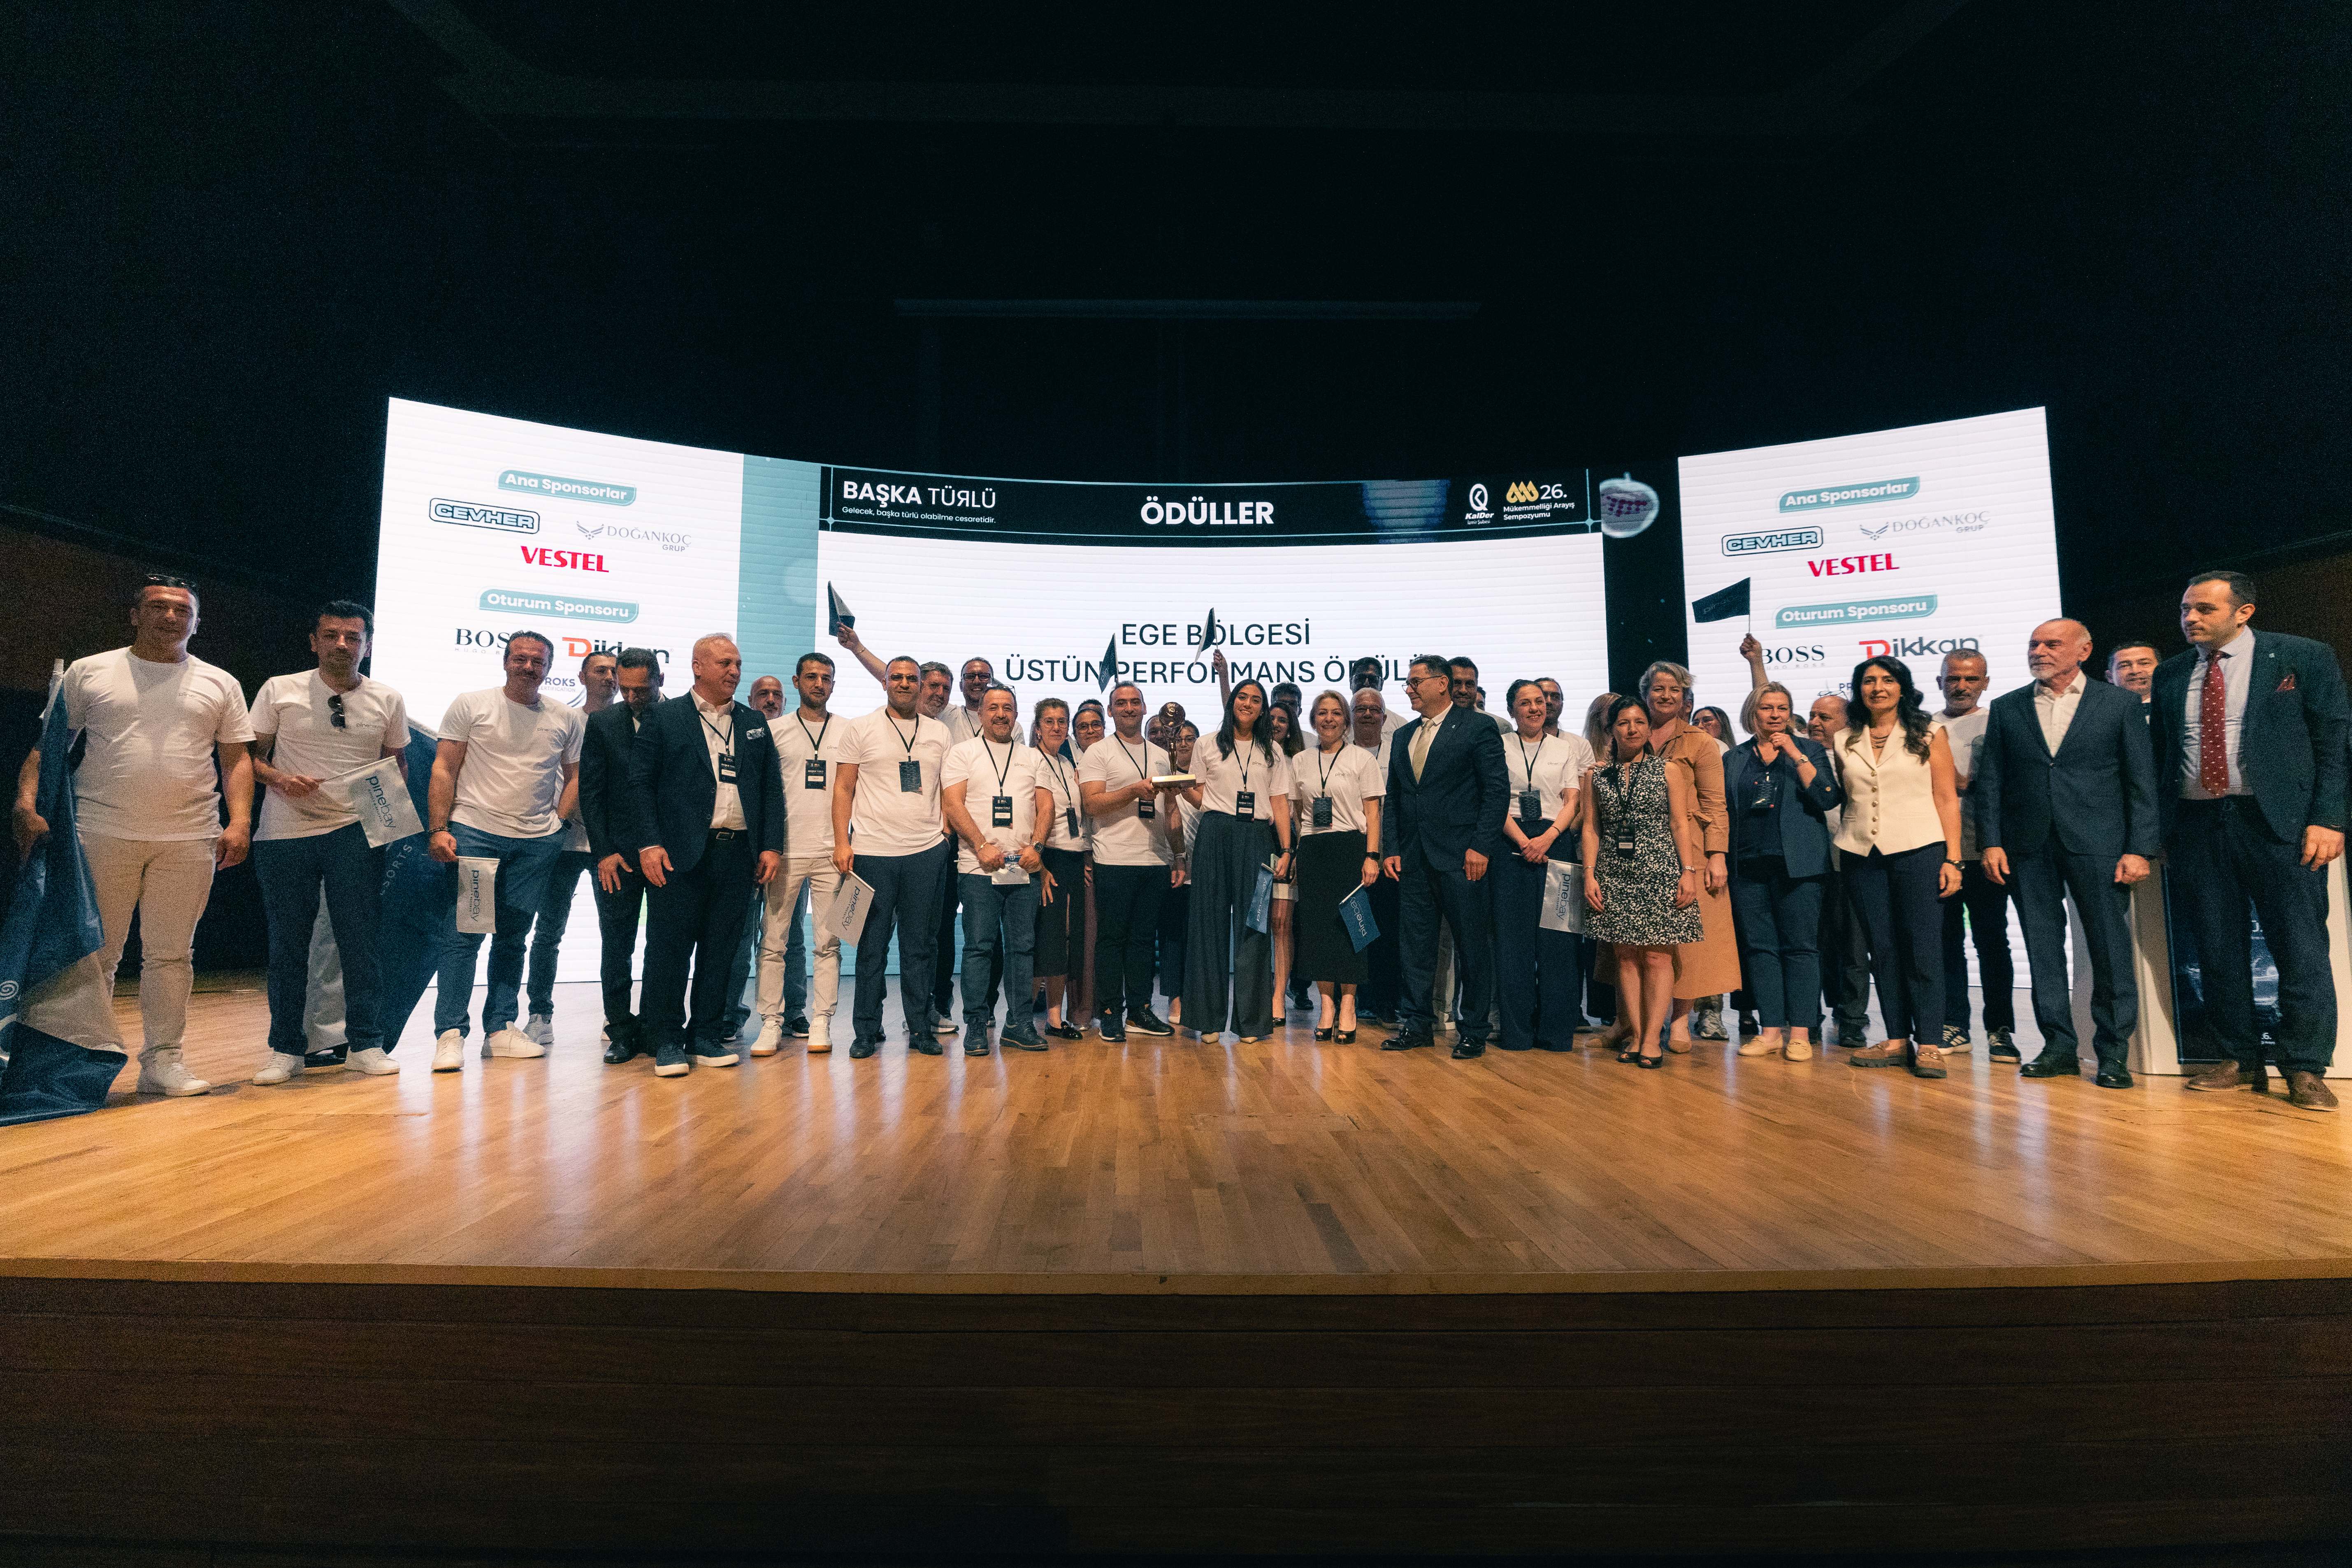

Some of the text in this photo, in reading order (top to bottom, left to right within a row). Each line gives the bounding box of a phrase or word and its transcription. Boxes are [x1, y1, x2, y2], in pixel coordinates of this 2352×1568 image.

[505, 474, 627, 500] Ana Sponsorlar
[843, 481, 922, 507] BAŞKA
[1540, 484, 1567, 500] 26.
[1785, 483, 1910, 507] Ana Sponsorlar
[434, 504, 534, 529] CEVHER
[842, 506, 875, 516] Gelecek,
[877, 509, 899, 518] başka
[922, 513, 953, 521] olabilme
[955, 515, 996, 523] cesaretidir.
[1141, 496, 1275, 525] ÖDÜLLER
[1503, 502, 1575, 513] Mükemmelliği Arayış
[1504, 512, 1551, 520] Sempozyumu
[1892, 510, 1990, 532] DOĞANKOÇ
[1956, 524, 1985, 534] GRUP
[608, 525, 692, 548] DOĞANKOÇ
[1727, 531, 1817, 552] CEVHER
[520, 545, 609, 573] VESTEL
[1808, 553, 1900, 577] VESTEL
[488, 593, 629, 618] Oturum Sponsoru
[1782, 601, 1927, 623] Oturum Sponsoru
[455, 628, 510, 649] BOS
[1122, 618, 1310, 646] EGE BÖLGESİ
[1006, 653, 1103, 683] ÜSTÜN
[545, 677, 576, 687] ROKS
[366, 775, 396, 829] pinebay
[471, 870, 481, 921] pinebay
[1556, 873, 1571, 920] pinebay
[841, 886, 861, 931] pinebay
[1349, 897, 1367, 937] pinebay
